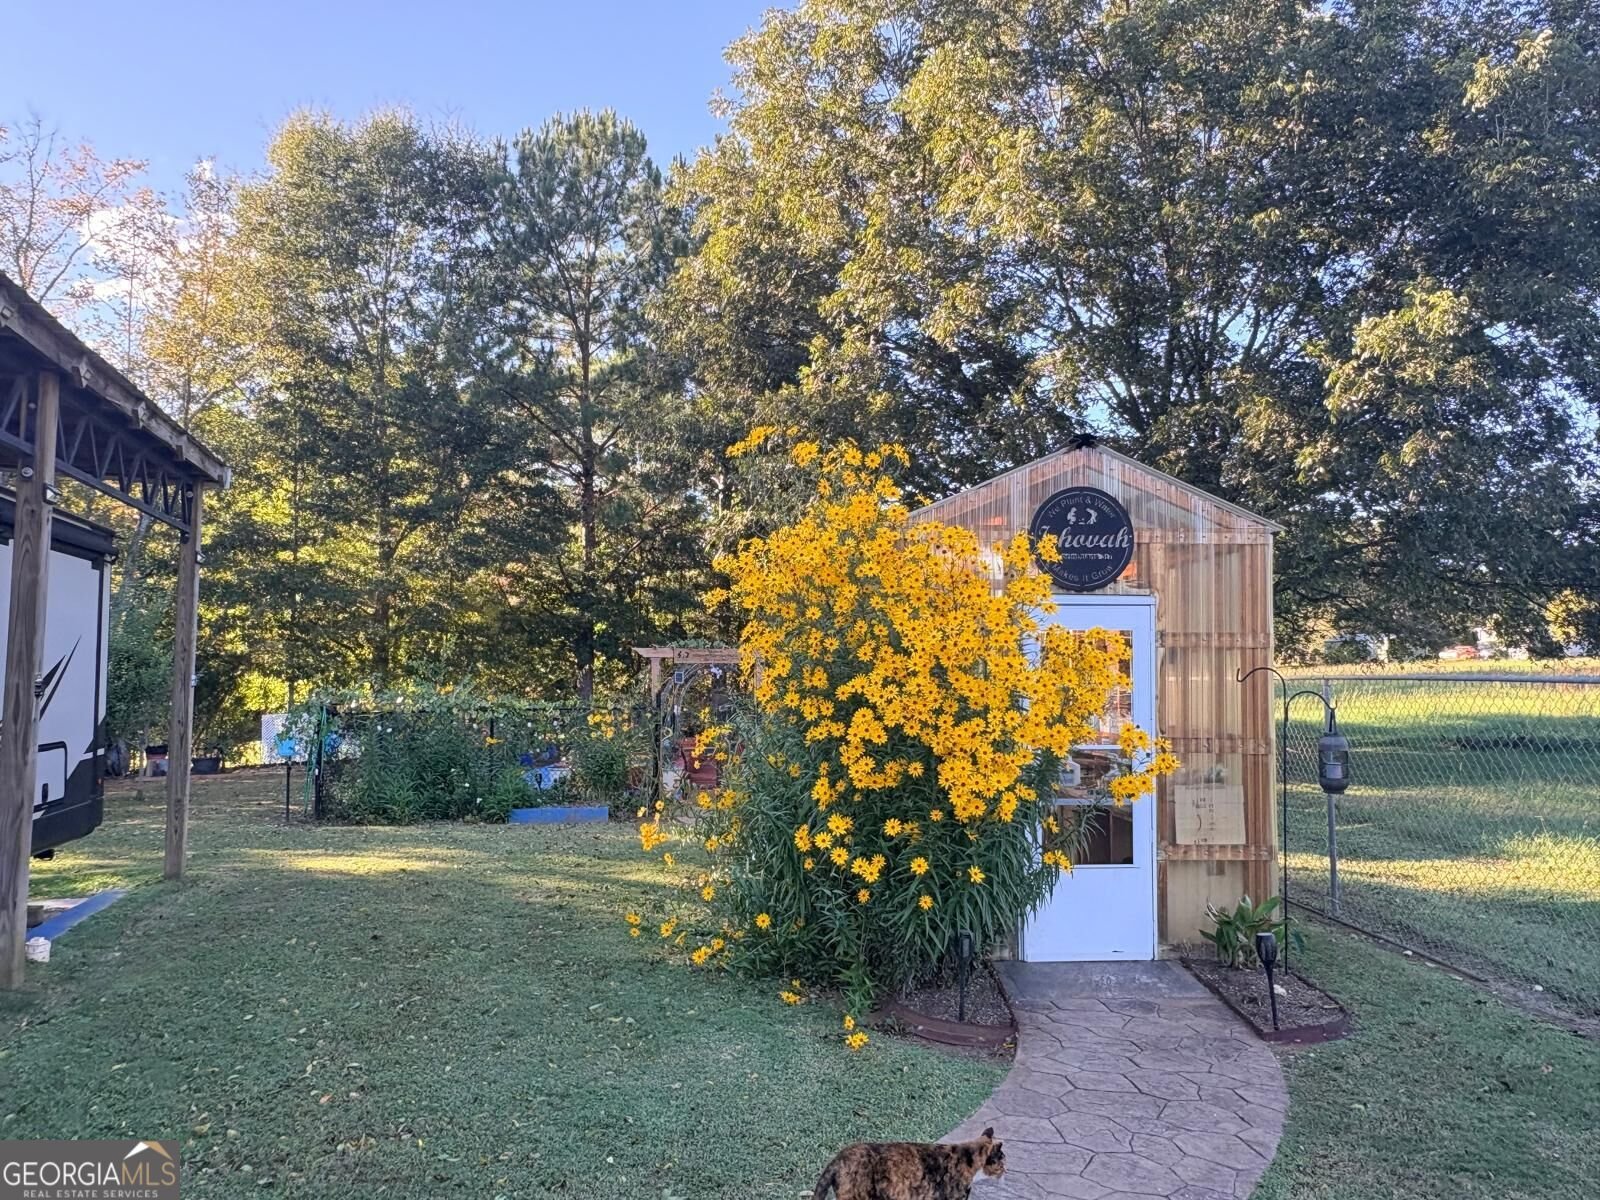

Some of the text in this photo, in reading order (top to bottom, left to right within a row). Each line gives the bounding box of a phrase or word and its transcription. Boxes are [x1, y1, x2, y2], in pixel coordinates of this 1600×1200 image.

[1060, 496, 1083, 508] Plant
[1085, 496, 1092, 504] &
[1038, 525, 1130, 549] Jhovah
